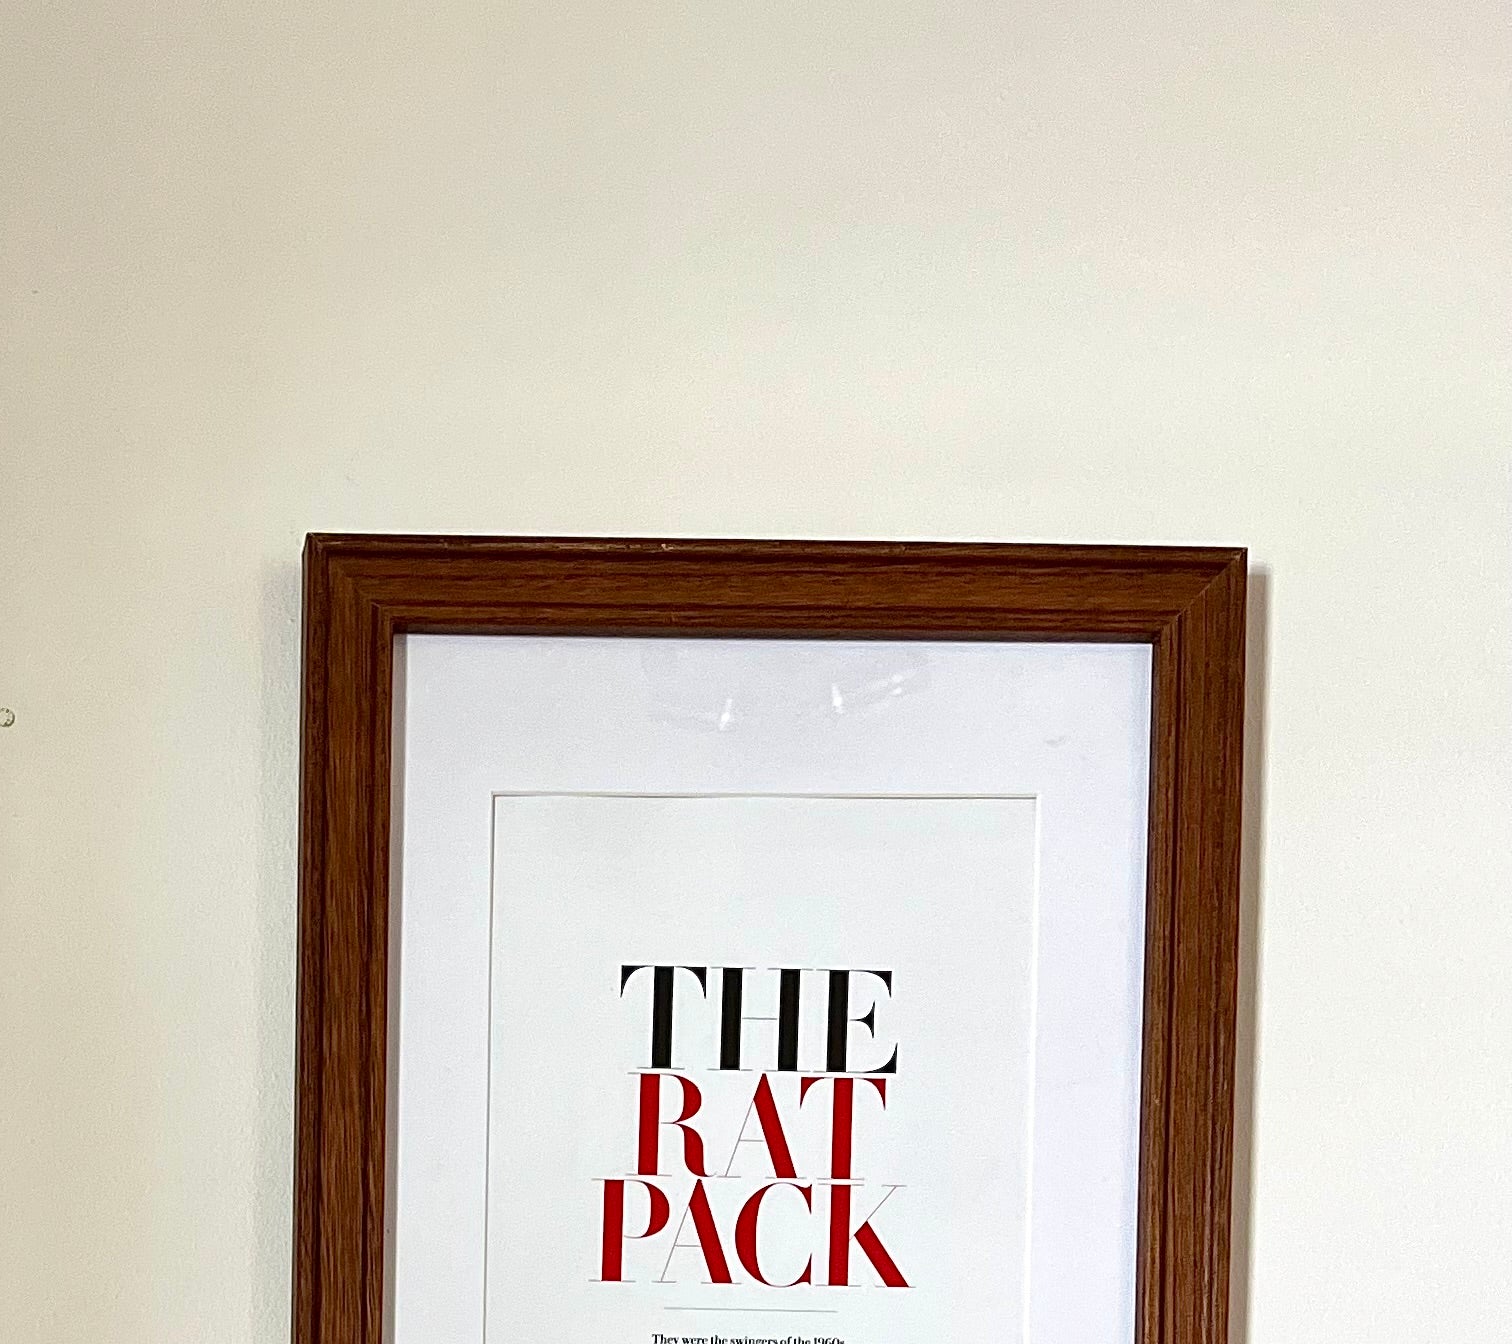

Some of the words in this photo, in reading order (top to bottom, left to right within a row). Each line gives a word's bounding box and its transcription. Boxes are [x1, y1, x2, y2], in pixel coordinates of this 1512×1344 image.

[620, 965, 898, 1074] THE
[628, 1073, 887, 1180] RAT
[588, 1178, 916, 1288] PACK
[682, 1336, 708, 1344] were
